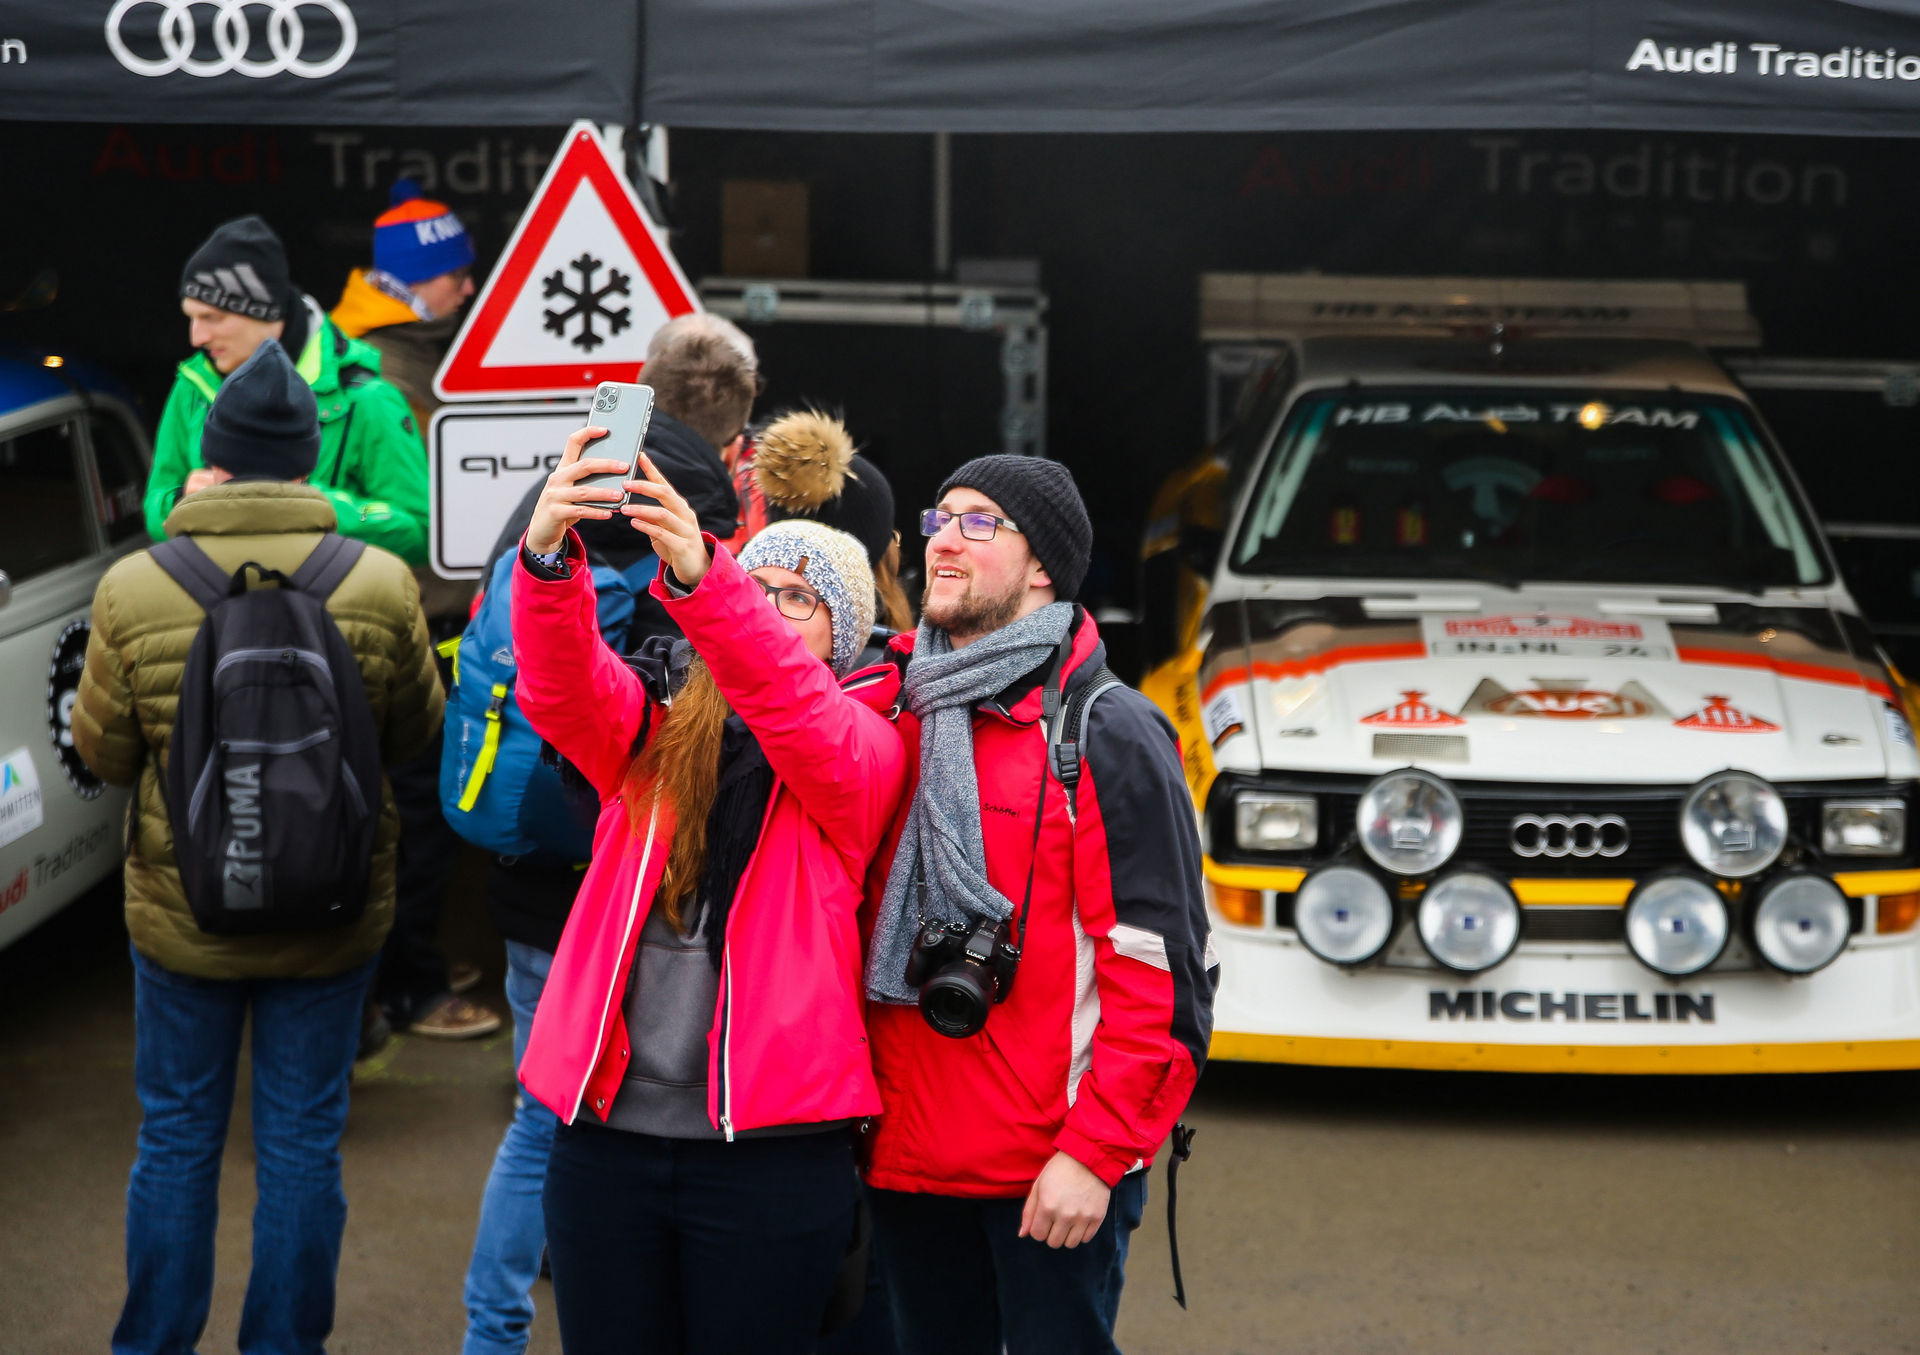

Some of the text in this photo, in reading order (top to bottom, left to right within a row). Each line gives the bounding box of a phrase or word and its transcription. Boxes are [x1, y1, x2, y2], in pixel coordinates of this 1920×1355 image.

[1626, 38, 1738, 74] Audi
[92, 127, 282, 184] Audi
[1239, 137, 1849, 206] Audi Tradition
[184, 281, 282, 321] adidas
[1334, 402, 1412, 426] HB
[224, 762, 263, 862] PUMA
[982, 802, 1022, 819] Schöffel
[33, 822, 110, 887] Tradition
[1428, 989, 1716, 1024] MICHELIN
